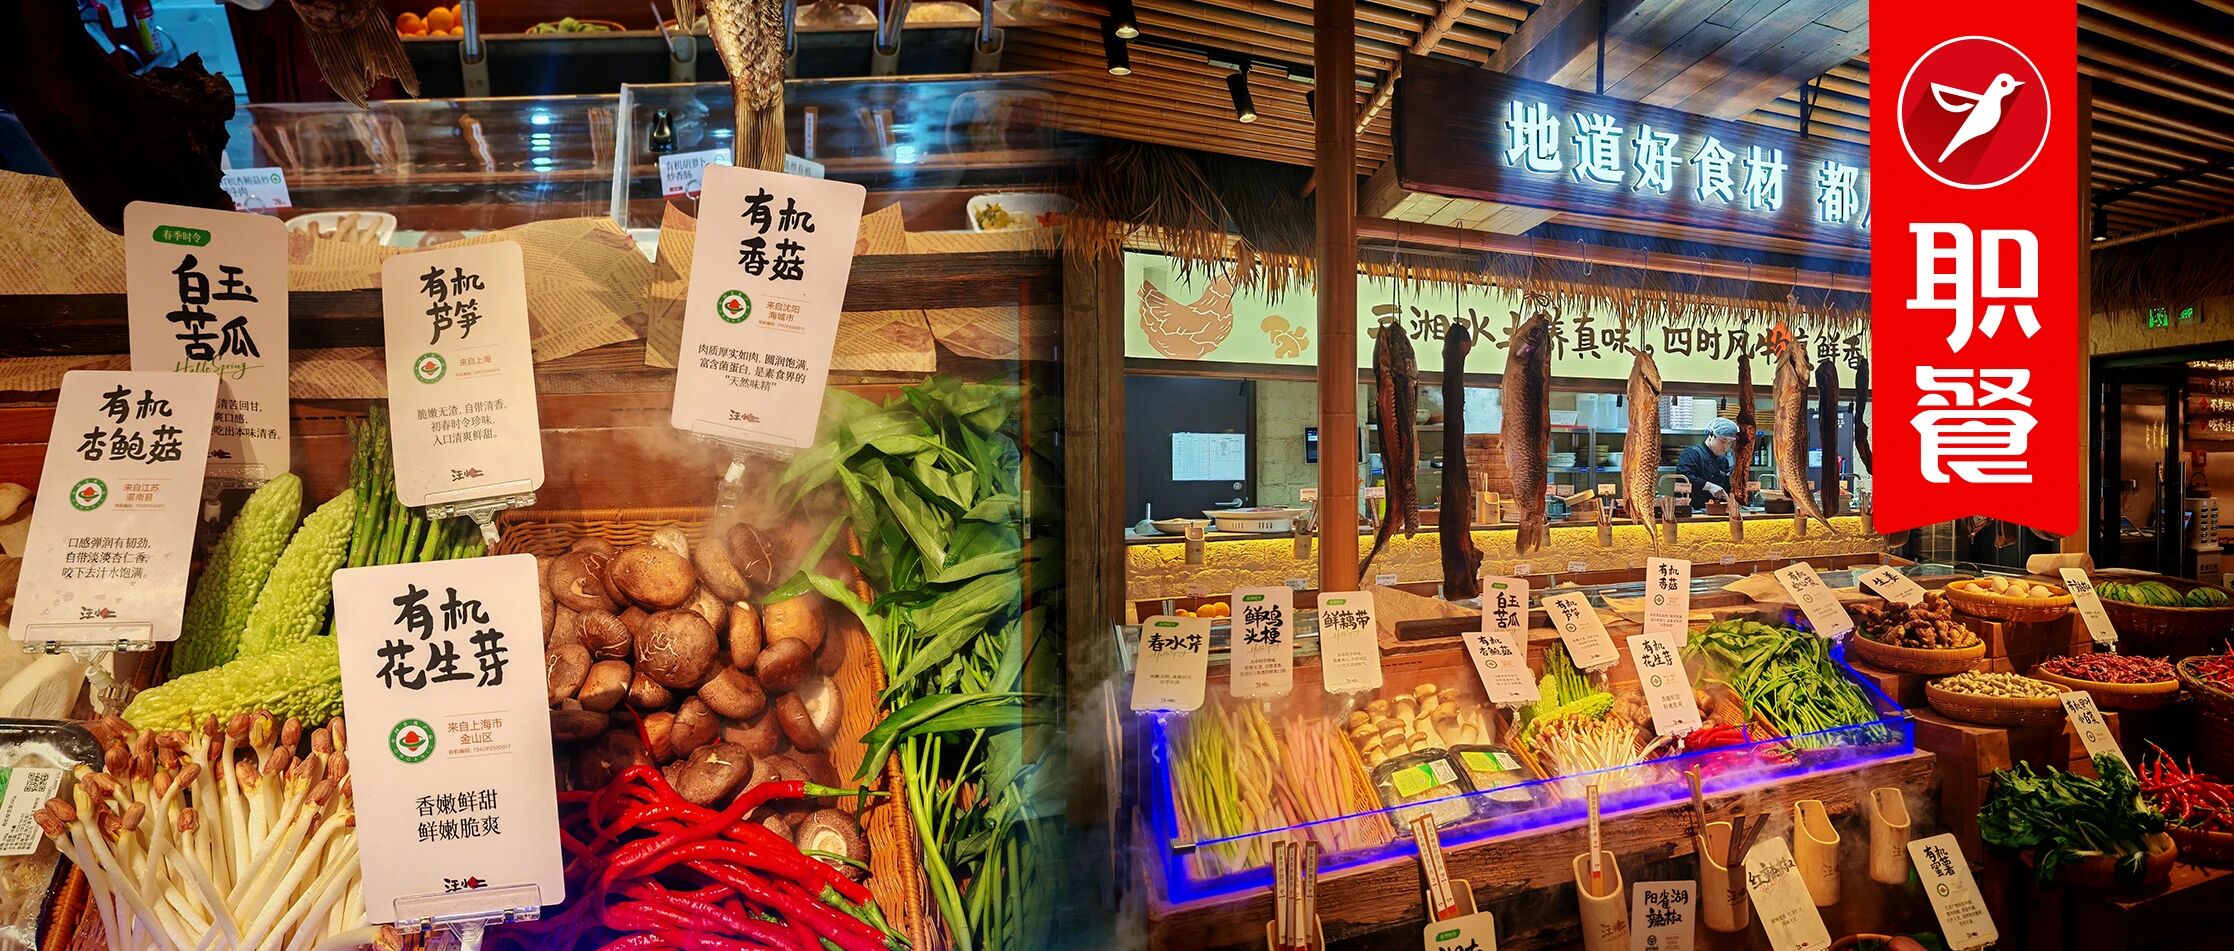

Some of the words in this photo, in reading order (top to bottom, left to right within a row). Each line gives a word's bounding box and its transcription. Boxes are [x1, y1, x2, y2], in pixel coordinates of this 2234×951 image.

[1503, 99, 1788, 212] 地道好食材
[1815, 160, 1871, 229] 都
[741, 187, 815, 234] 有机
[162, 229, 202, 243] 春季时令
[738, 236, 805, 281] 香菇
[172, 254, 259, 306] 白玉
[420, 266, 485, 302] 有机
[766, 301, 800, 314] 来自沈阳
[768, 311, 795, 322] 海城市
[426, 299, 482, 346] 芦笋
[166, 305, 261, 361] 苦瓜
[212, 354, 264, 384] Spring
[459, 355, 492, 367] 来自上海
[99, 385, 173, 423] 有机
[211, 425, 281, 440] 吃出本味清香。
[77, 425, 183, 464] 杏鲍菇
[123, 483, 160, 492] 来自江苏
[62, 567, 150, 579] 咬下去汁水饱满。
[1658, 563, 1680, 577] 有机
[1496, 592, 1520, 608] 白玉
[393, 583, 490, 640] 有机
[1243, 604, 1284, 628] 鲜鸡
[1322, 609, 1371, 630] 鲜藕带
[1493, 610, 1520, 629] 苦瓜
[1148, 633, 1203, 653] 春水芹
[1243, 626, 1282, 645] 头梗
[1478, 635, 1502, 646] 有机
[1642, 640, 1666, 654] 有机
[375, 628, 509, 690] 花生芽
[1642, 651, 1673, 668] 花生芽
[447, 718, 503, 733] 来自上海市
[460, 731, 493, 745] 金山区
[416, 788, 498, 818] 香嫩鲜甜
[418, 814, 501, 844] 鲜嫩脆爽
[1923, 845, 1948, 862] 有机
[1645, 889, 1689, 909] 阳雀湖
[1646, 908, 1683, 928] 辣椒
